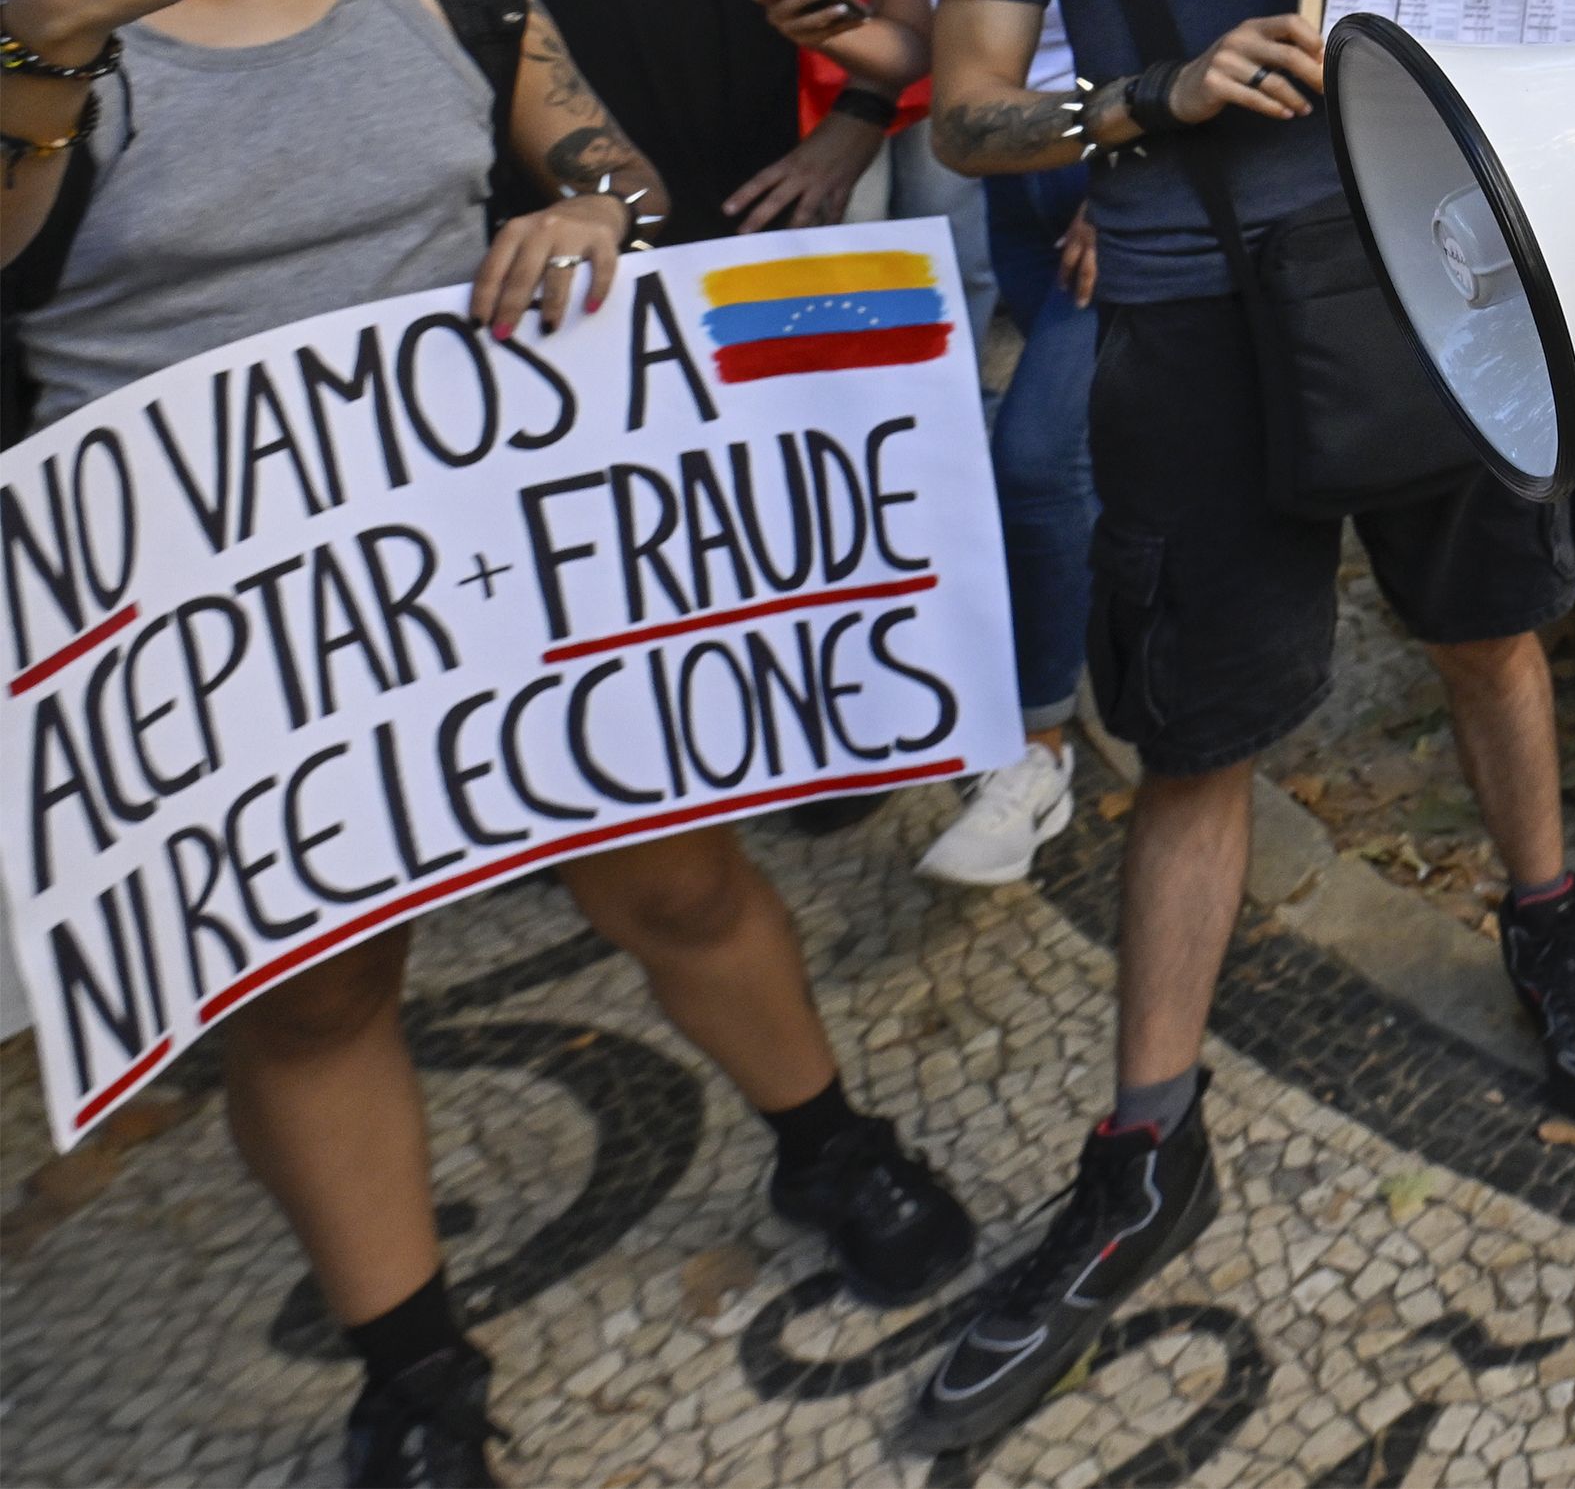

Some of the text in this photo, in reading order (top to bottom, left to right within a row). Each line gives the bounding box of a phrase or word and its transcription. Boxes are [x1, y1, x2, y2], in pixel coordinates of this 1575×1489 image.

[0, 271, 720, 670] NO VAMOS A
[31, 525, 459, 895] ACEPTAR
[520, 416, 931, 640] FRAUDE
[47, 867, 168, 1094] NI
